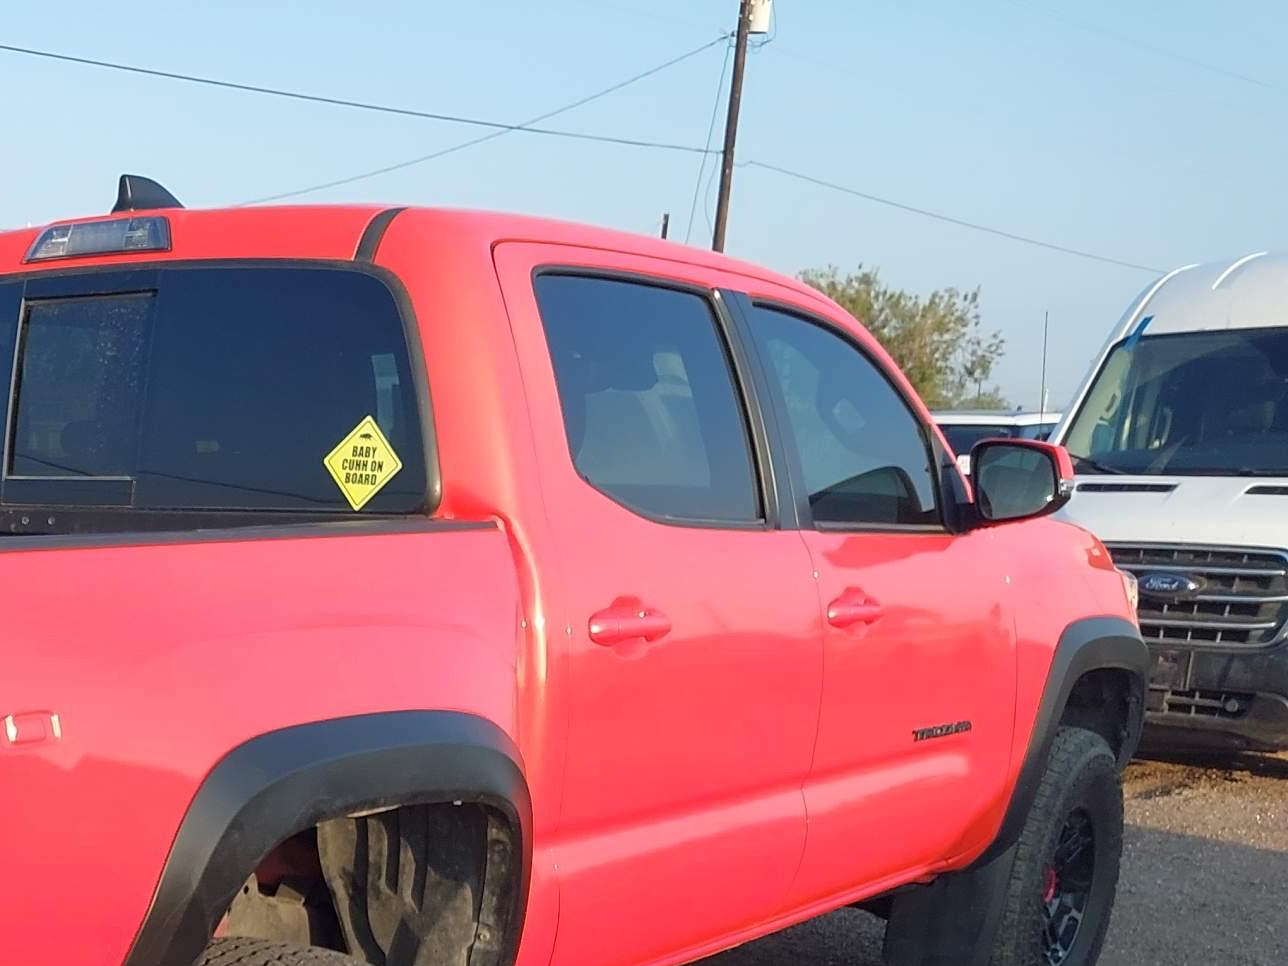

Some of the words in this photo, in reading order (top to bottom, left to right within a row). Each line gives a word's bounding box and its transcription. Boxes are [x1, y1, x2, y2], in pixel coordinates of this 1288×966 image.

[352, 445, 377, 458] BABY
[370, 460, 383, 472] ON
[345, 472, 377, 485] BOARD
